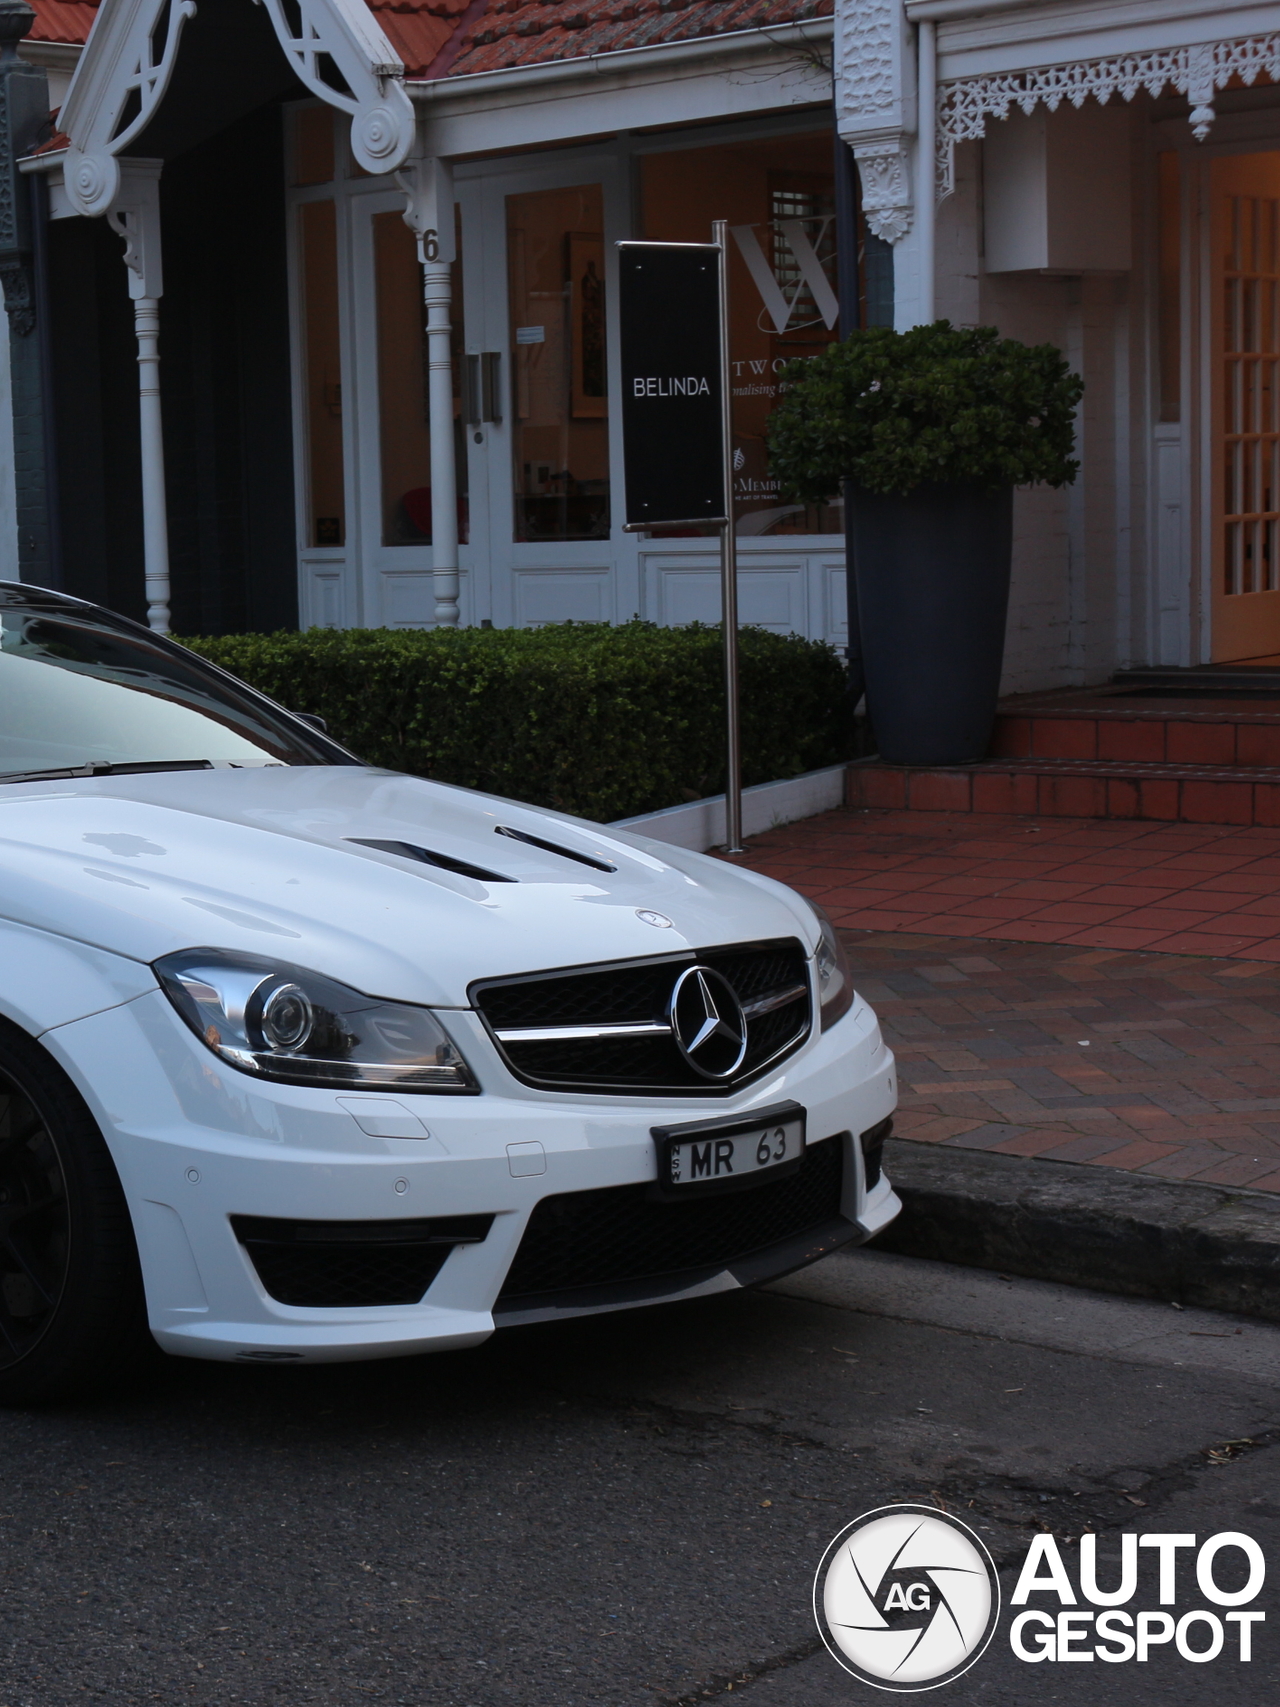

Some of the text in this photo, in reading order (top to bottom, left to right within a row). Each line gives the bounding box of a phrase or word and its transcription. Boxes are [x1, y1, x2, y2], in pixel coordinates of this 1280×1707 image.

[423, 228, 439, 262] 6
[633, 377, 710, 397] BELINDA
[671, 1145, 682, 1182] NSW
[690, 1127, 787, 1179] MR 63
